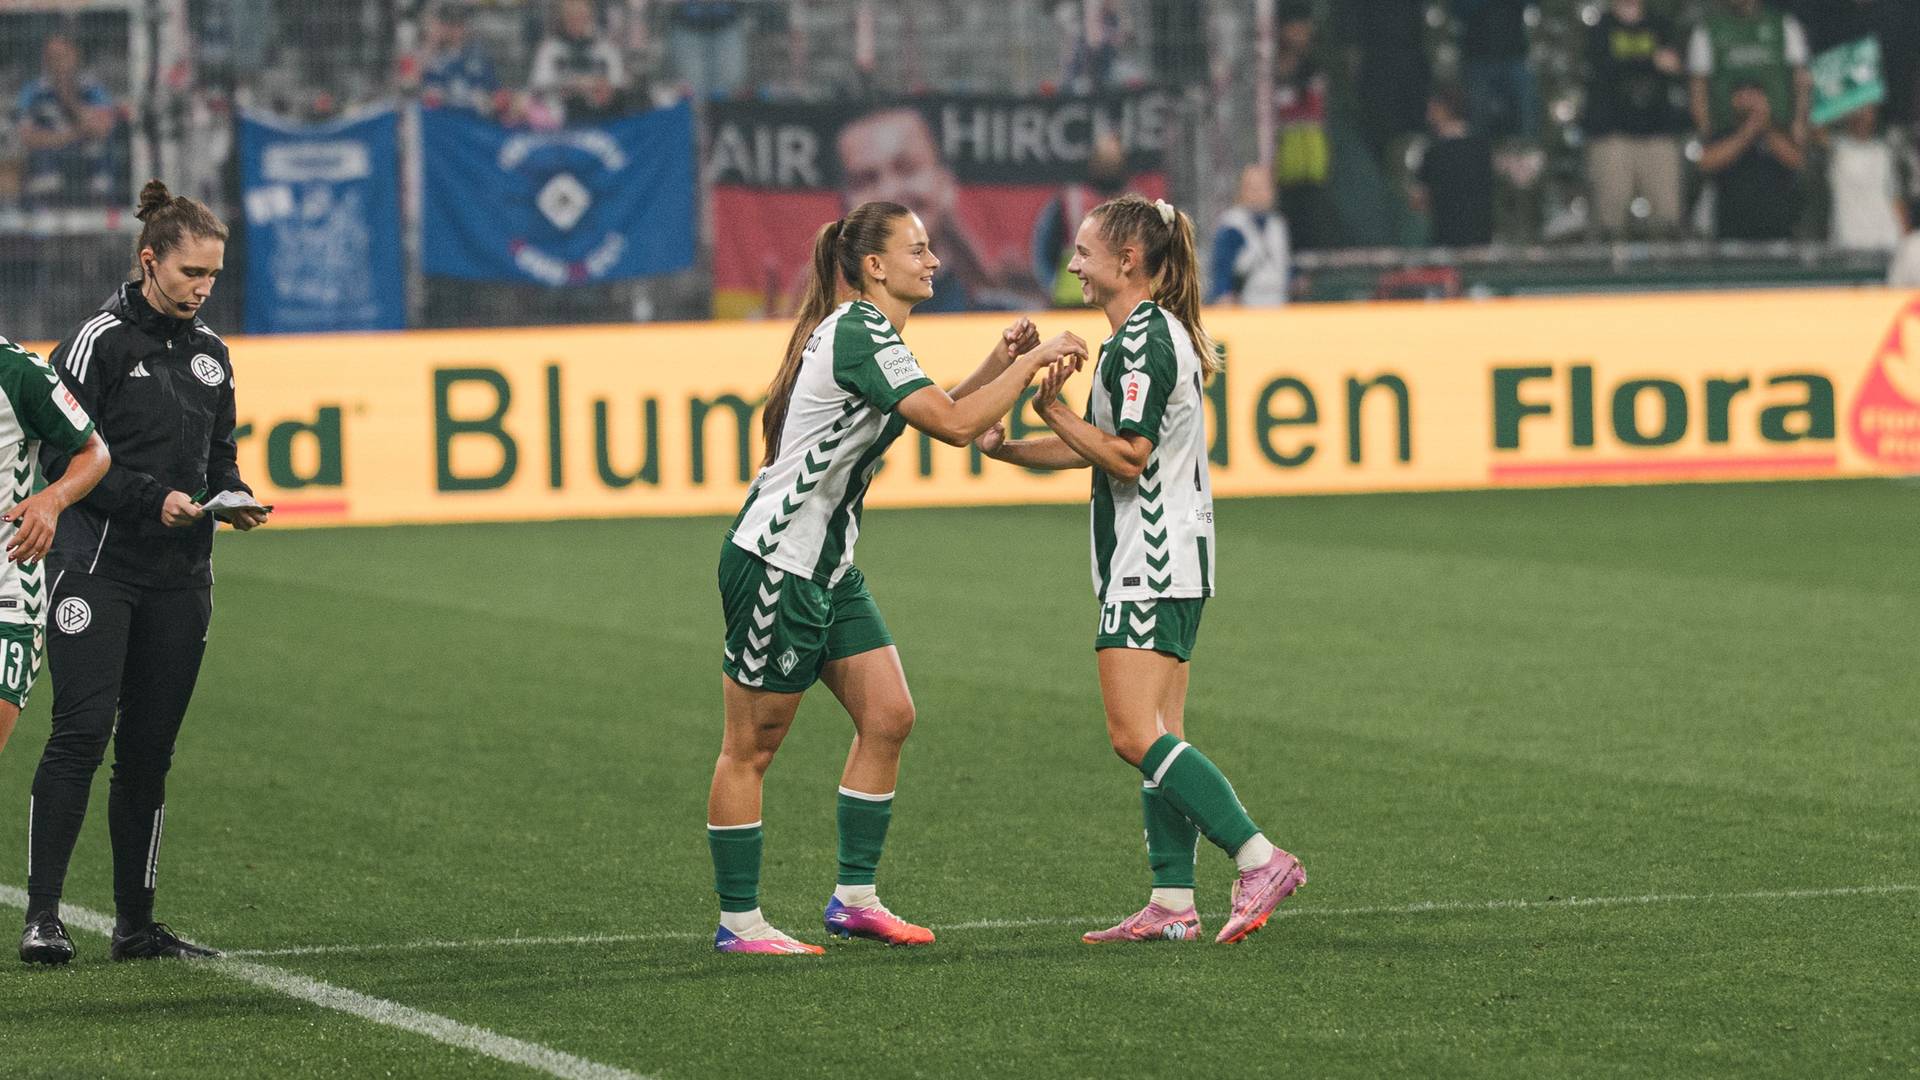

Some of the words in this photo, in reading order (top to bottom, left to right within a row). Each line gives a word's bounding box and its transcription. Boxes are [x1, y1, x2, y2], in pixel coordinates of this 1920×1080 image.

[434, 344, 1410, 491] Blumeden
[1493, 366, 1836, 449] Flora
[0, 638, 24, 690] 13
